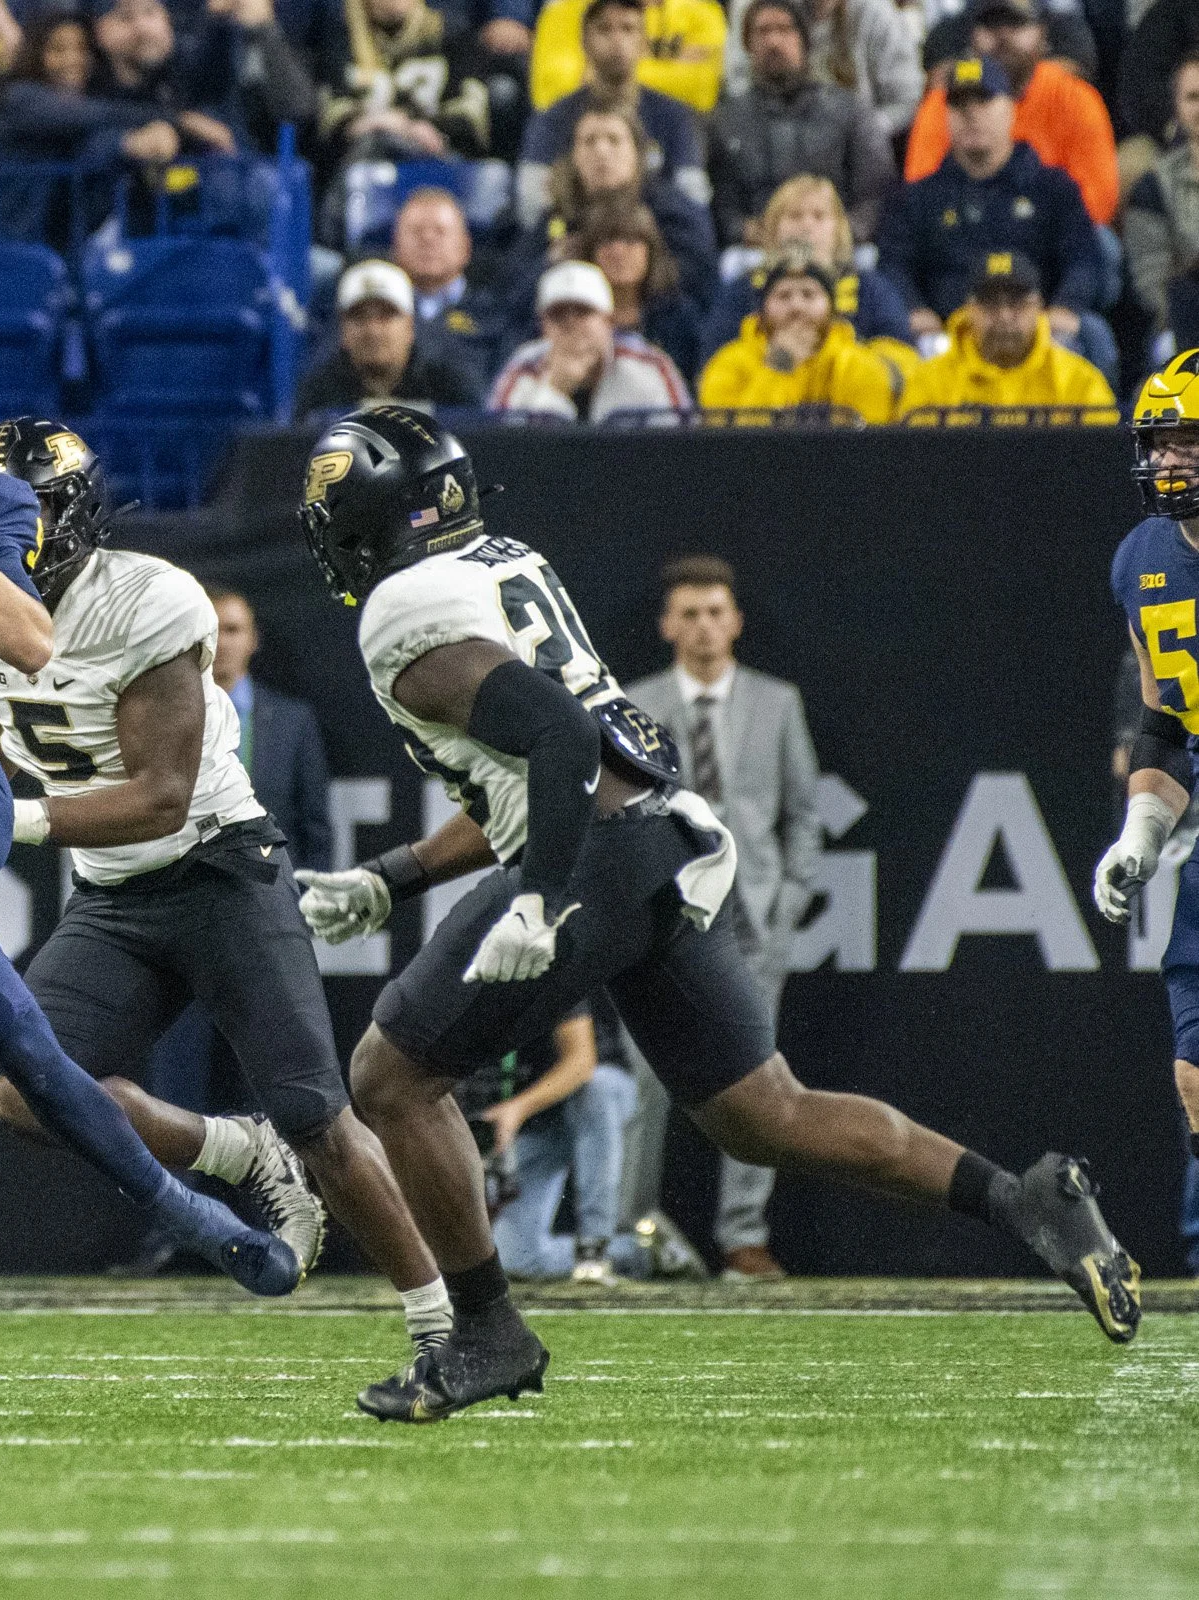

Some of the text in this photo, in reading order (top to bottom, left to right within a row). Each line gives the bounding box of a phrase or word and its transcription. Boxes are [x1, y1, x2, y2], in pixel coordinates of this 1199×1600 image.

[44, 432, 87, 478] P
[304, 450, 354, 506] P
[8, 697, 100, 785] 5
